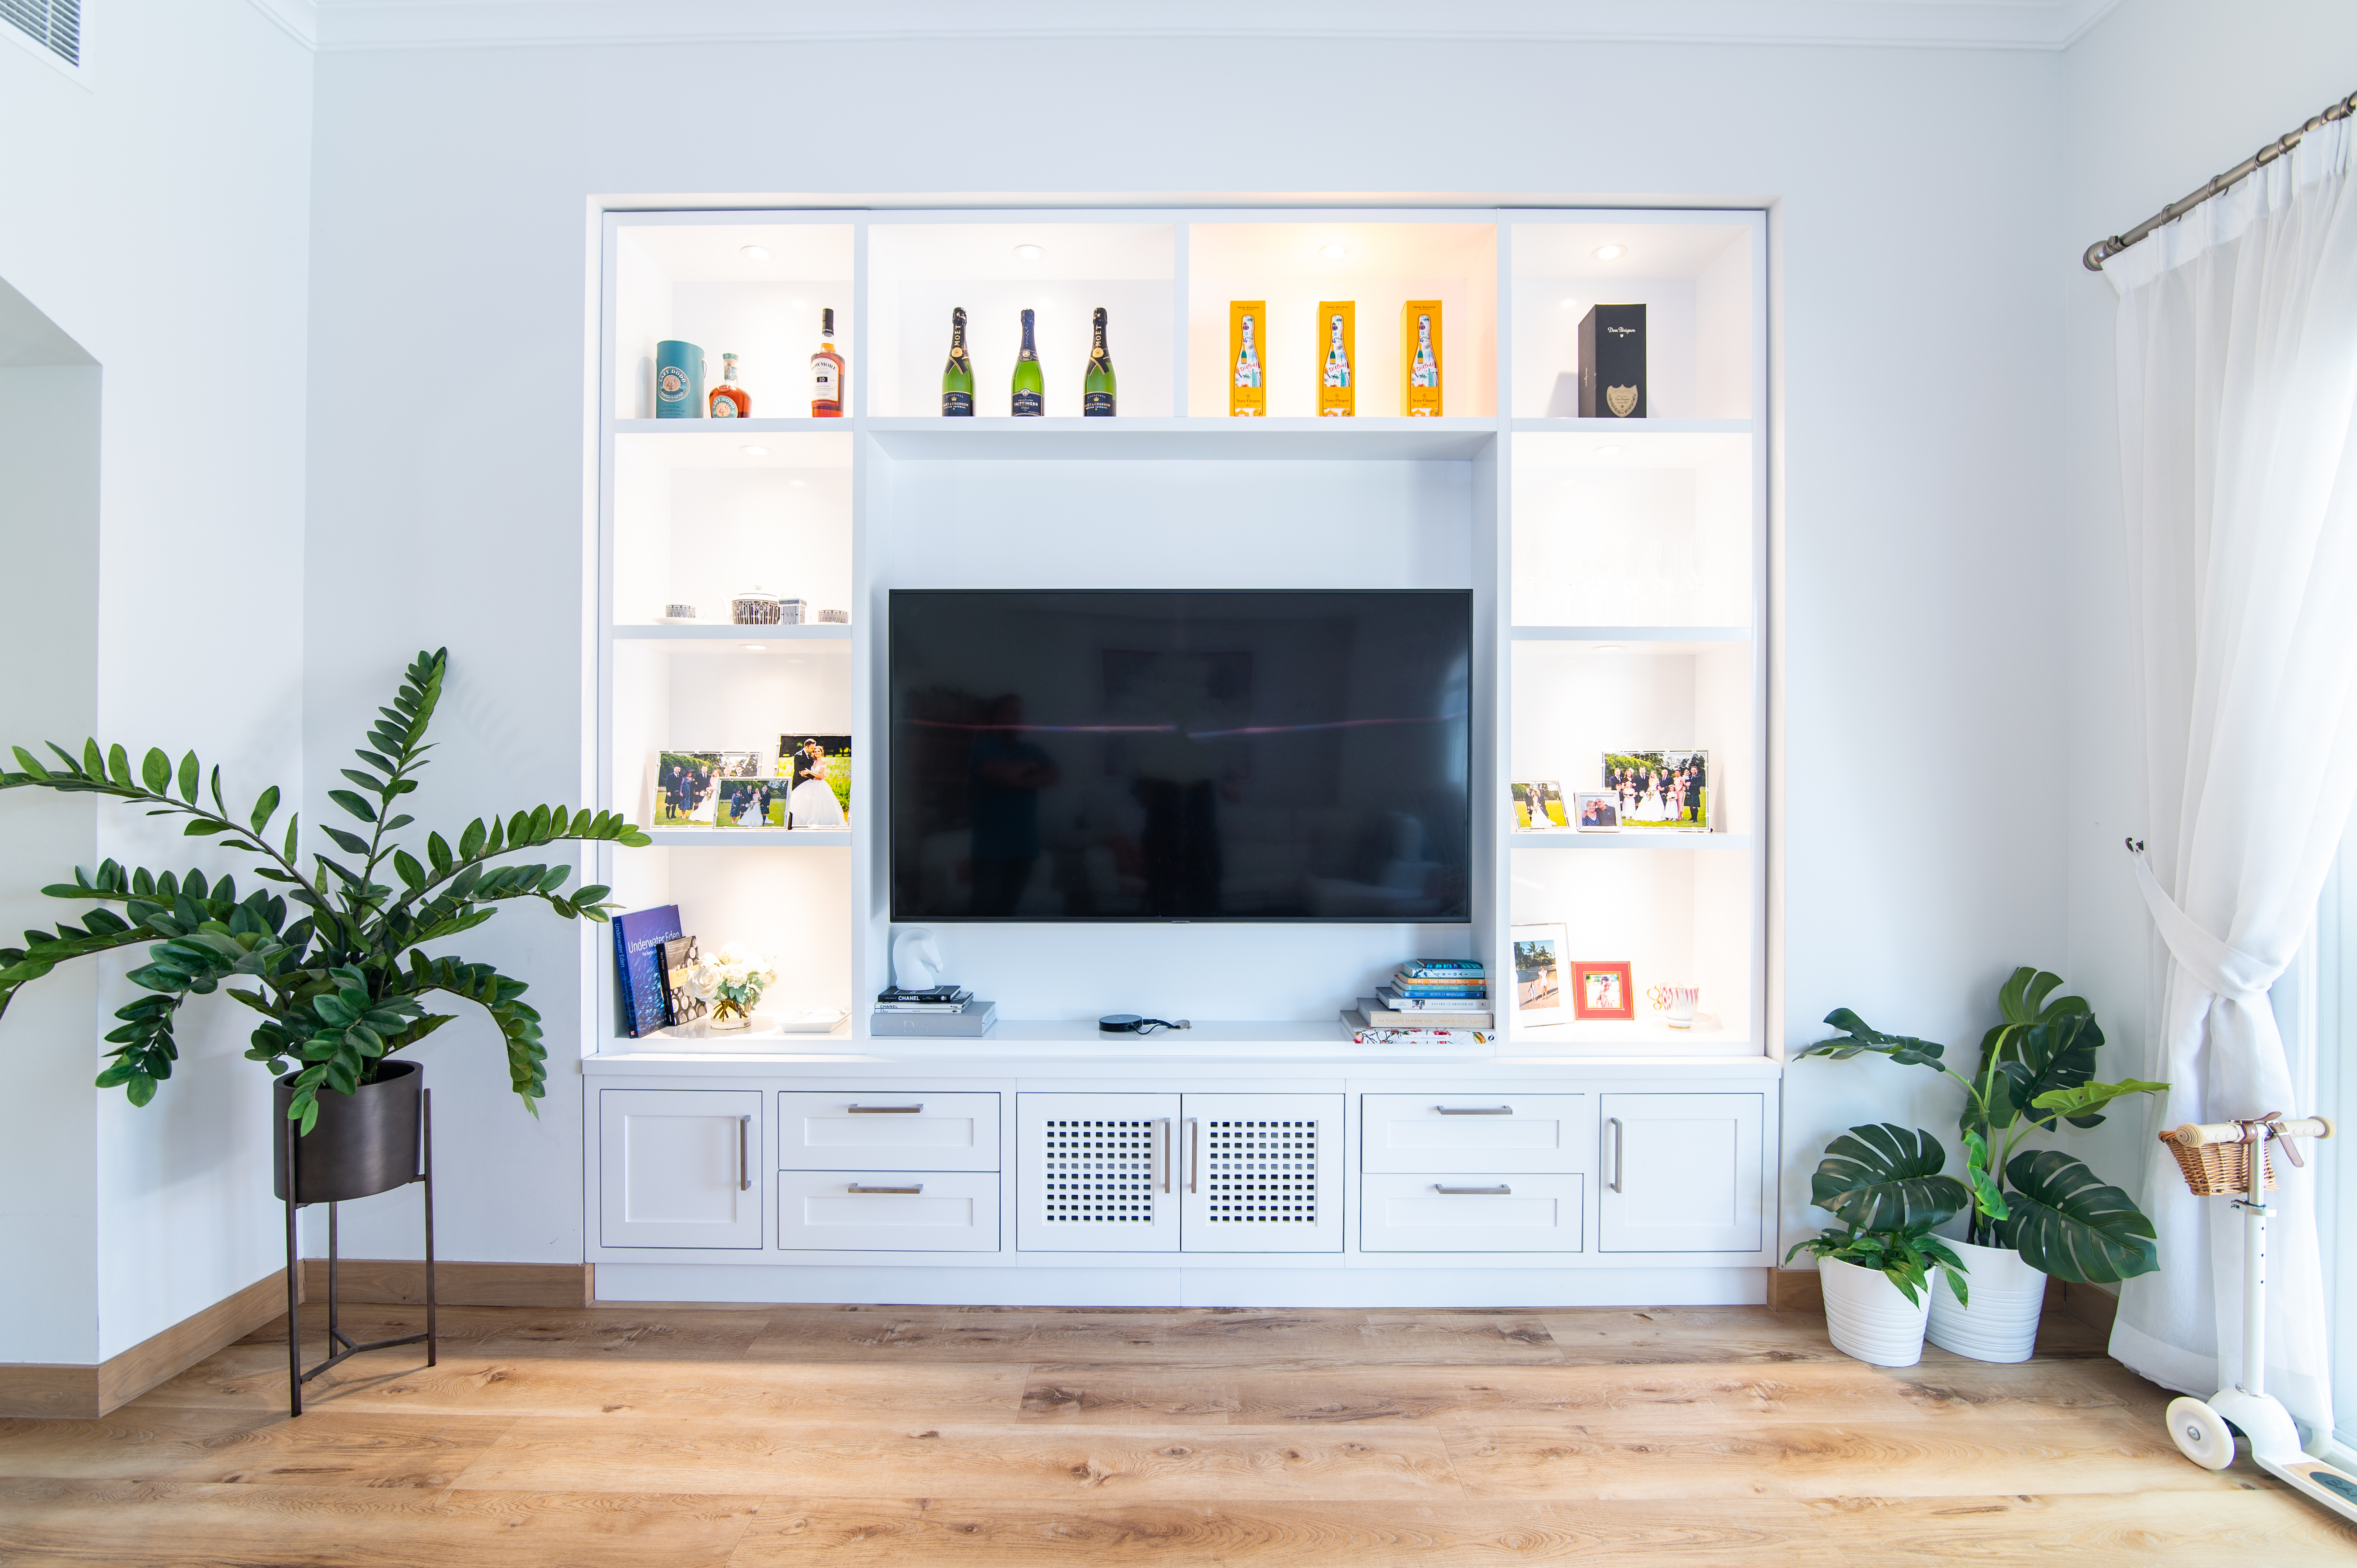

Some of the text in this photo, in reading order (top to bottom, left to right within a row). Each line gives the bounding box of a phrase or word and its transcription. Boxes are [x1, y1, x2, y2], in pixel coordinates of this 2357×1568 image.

[811, 362, 837, 371] BOWMORE
[1240, 362, 1257, 372] DUBAI
[1329, 362, 1346, 372] DUBAI
[1416, 361, 1434, 371] DUBAI
[659, 369, 686, 383] LAZY DODO
[713, 397, 735, 409] LAZY DODO
[628, 936, 665, 953] Underwater
[903, 1020, 931, 1032] Dior
